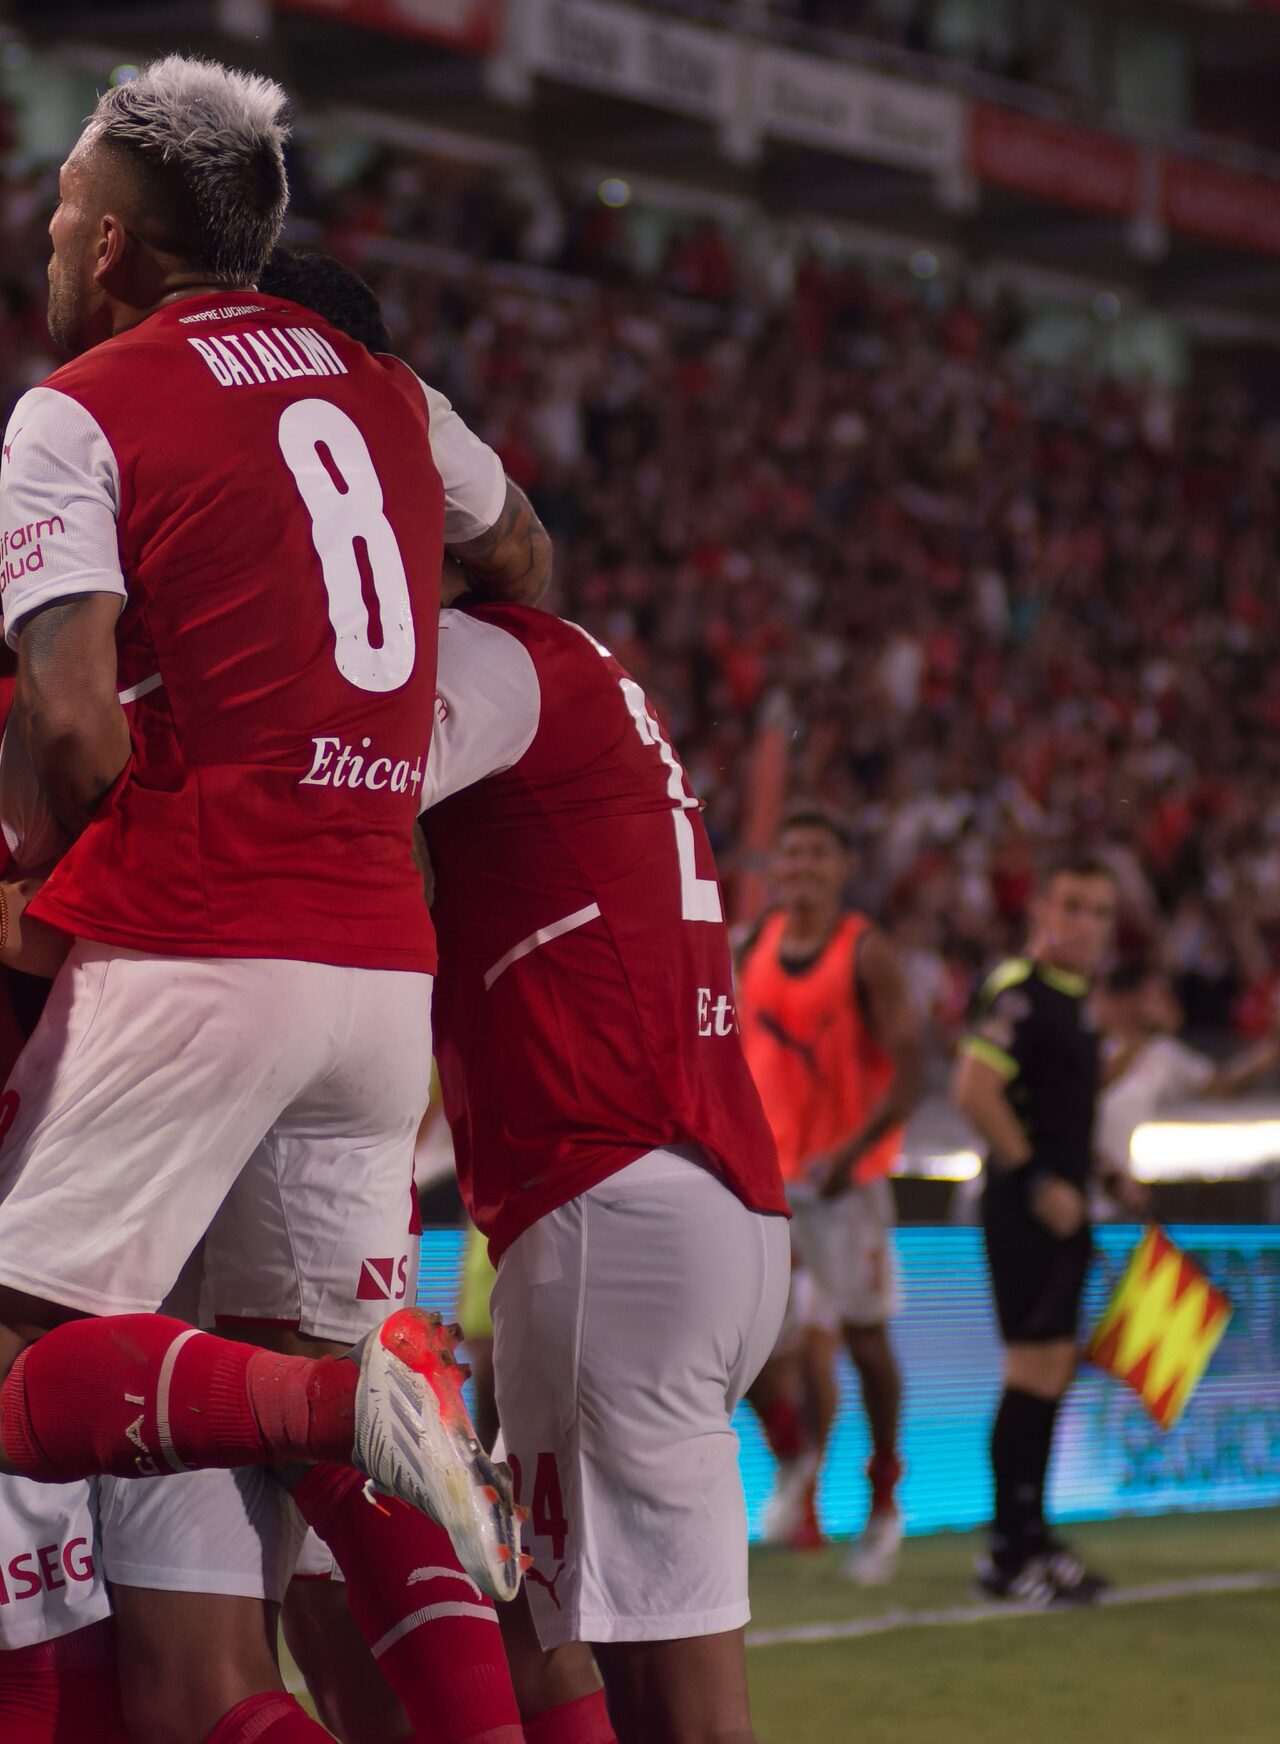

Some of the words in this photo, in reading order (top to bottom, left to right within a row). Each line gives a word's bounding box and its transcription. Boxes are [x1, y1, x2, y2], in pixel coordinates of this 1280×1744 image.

[187, 328, 349, 387] BATALLINI
[278, 398, 416, 692] 8
[298, 737, 422, 797] Etica+
